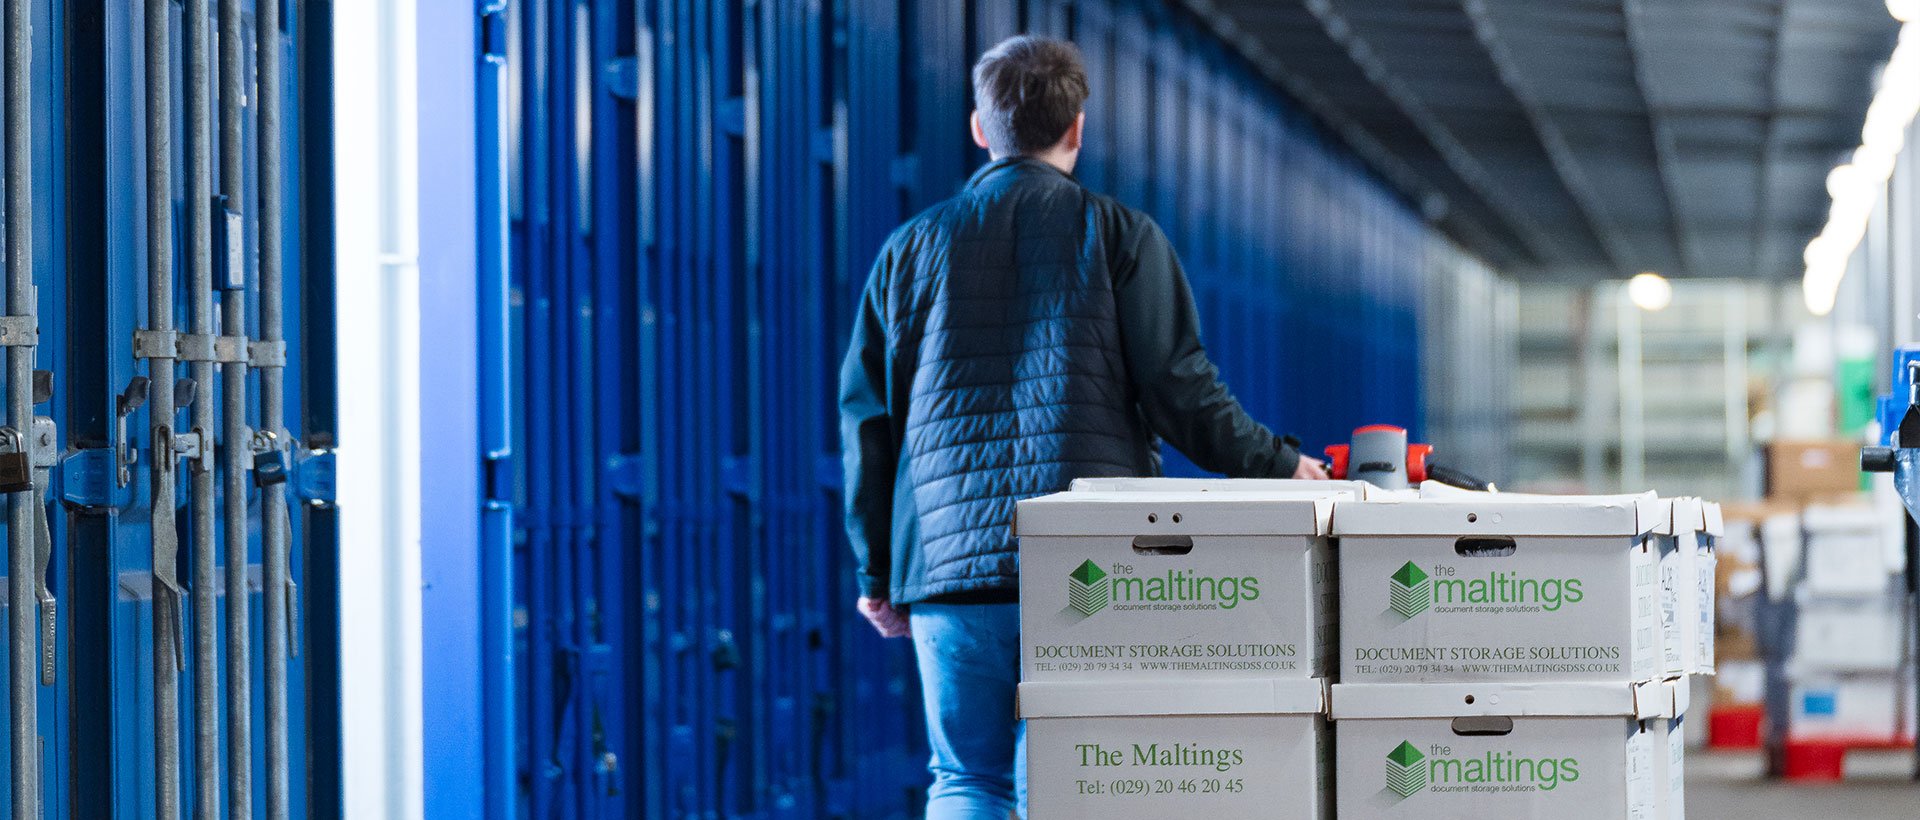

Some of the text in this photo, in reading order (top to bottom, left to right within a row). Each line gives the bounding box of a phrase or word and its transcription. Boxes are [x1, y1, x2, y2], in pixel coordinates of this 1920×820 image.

[1113, 563, 1133, 574] the
[1434, 564, 1455, 576] the
[1112, 569, 1259, 609] maltings
[1434, 571, 1583, 611] maltings
[1113, 603, 1151, 611] document
[1153, 604, 1181, 612] storage
[1475, 606, 1504, 614] storage
[1035, 644, 1296, 658] DOCUMENT STORAGE SOLUTIONS
[1355, 646, 1619, 660] DOCUMENT STORAGE SOLUTIONS
[1035, 661, 1296, 672] TEL: (029) 20 79 34 34 WWW.THEMALTINGSDSS.CO.UK
[1355, 665, 1376, 673] TEL:
[1380, 665, 1402, 674] (029)
[1405, 665, 1415, 673] 20
[1418, 665, 1428, 673] 79
[1462, 664, 1620, 672] WWW.THEMALTINGSDSS.CO.UK
[1430, 744, 1451, 755] the
[1075, 743, 1243, 772] The Maltings
[1430, 751, 1579, 790] maltings
[1076, 778, 1243, 796] Tel: (029) 20 46 20 45
[1471, 785, 1500, 793] storage
[1502, 784, 1536, 792] solutions
